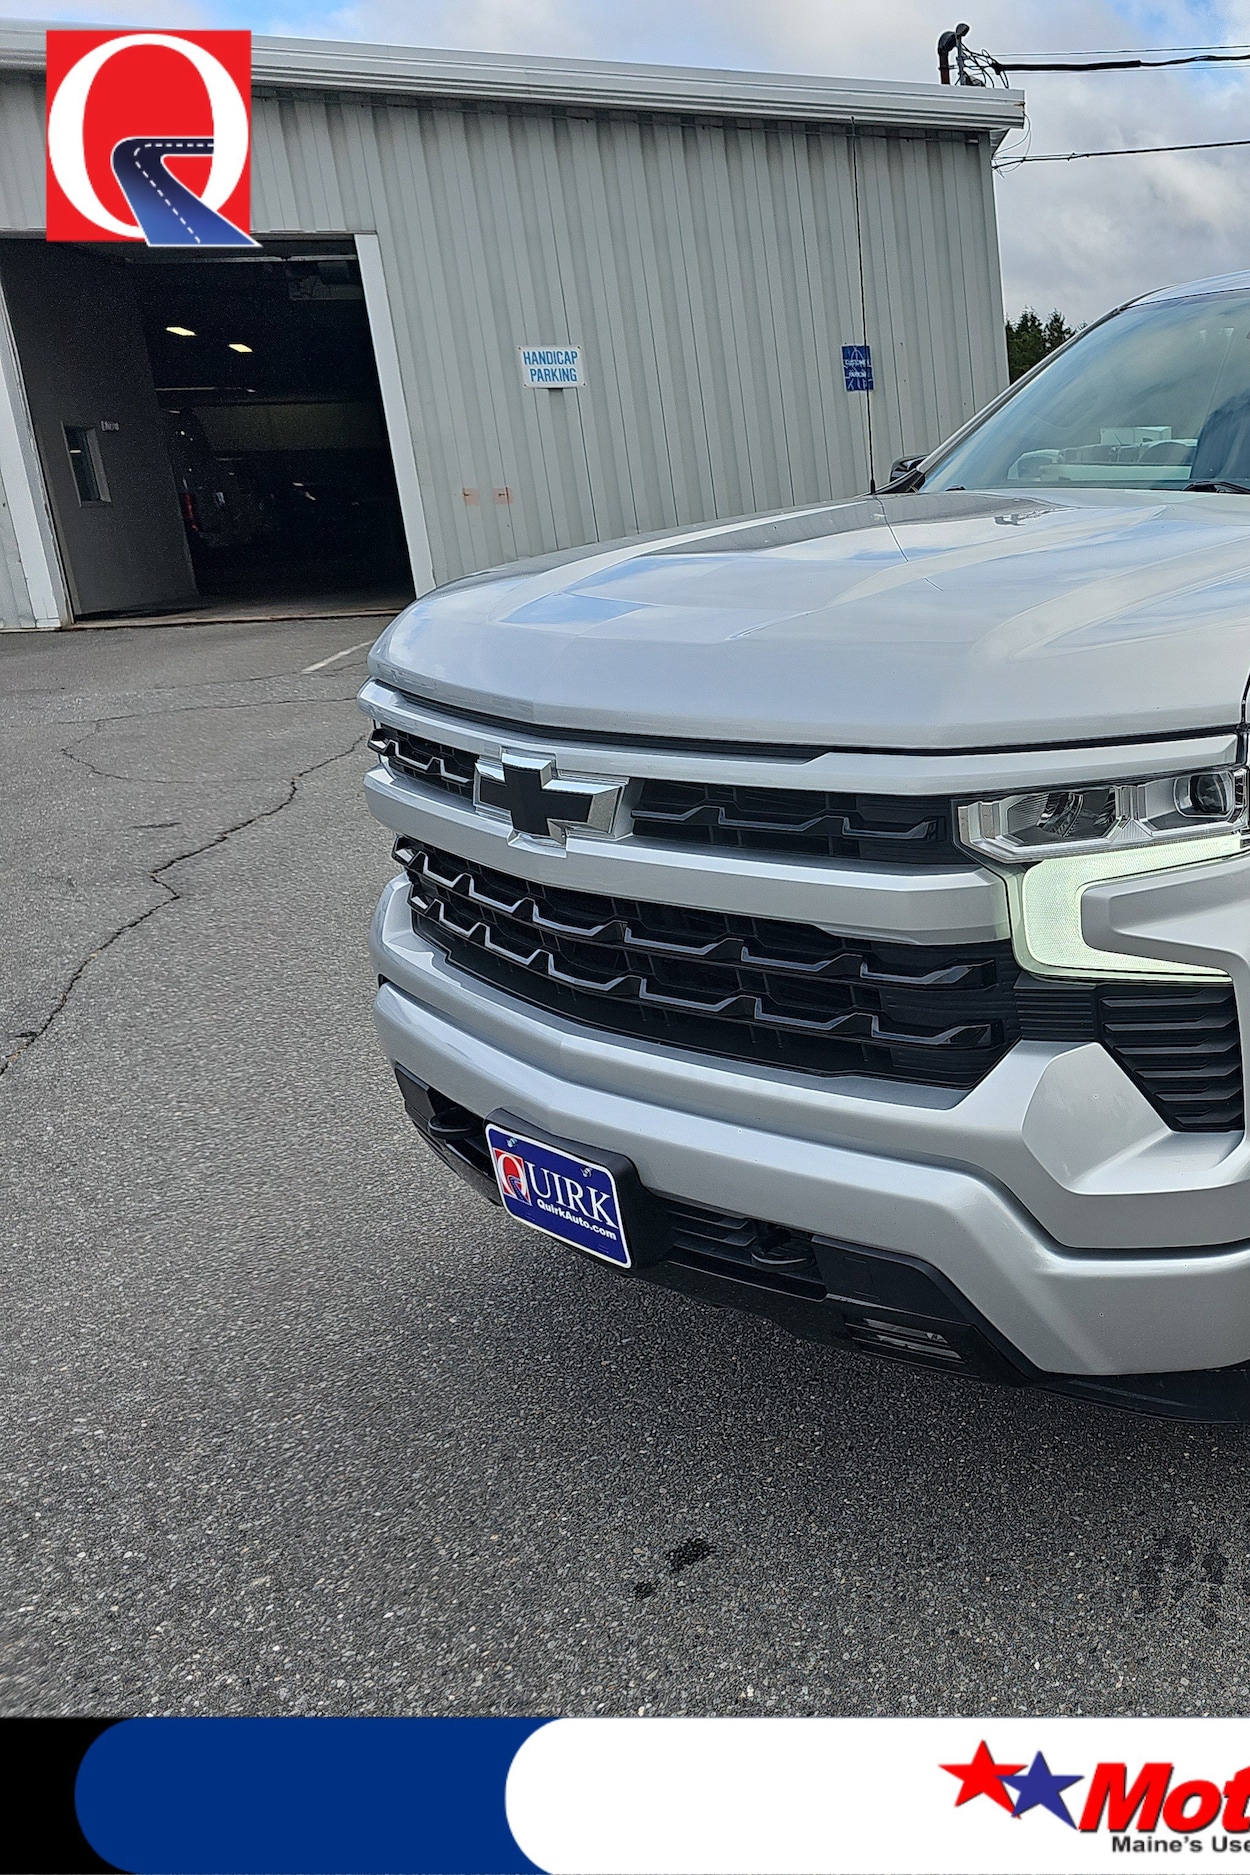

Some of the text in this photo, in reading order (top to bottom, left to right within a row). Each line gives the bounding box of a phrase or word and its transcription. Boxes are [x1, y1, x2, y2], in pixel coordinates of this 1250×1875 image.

[522, 350, 579, 365] HANDICAP
[529, 367, 578, 382] PARKING
[496, 1152, 619, 1229] QUIRK
[537, 1198, 617, 1241] QuirkAuto.com
